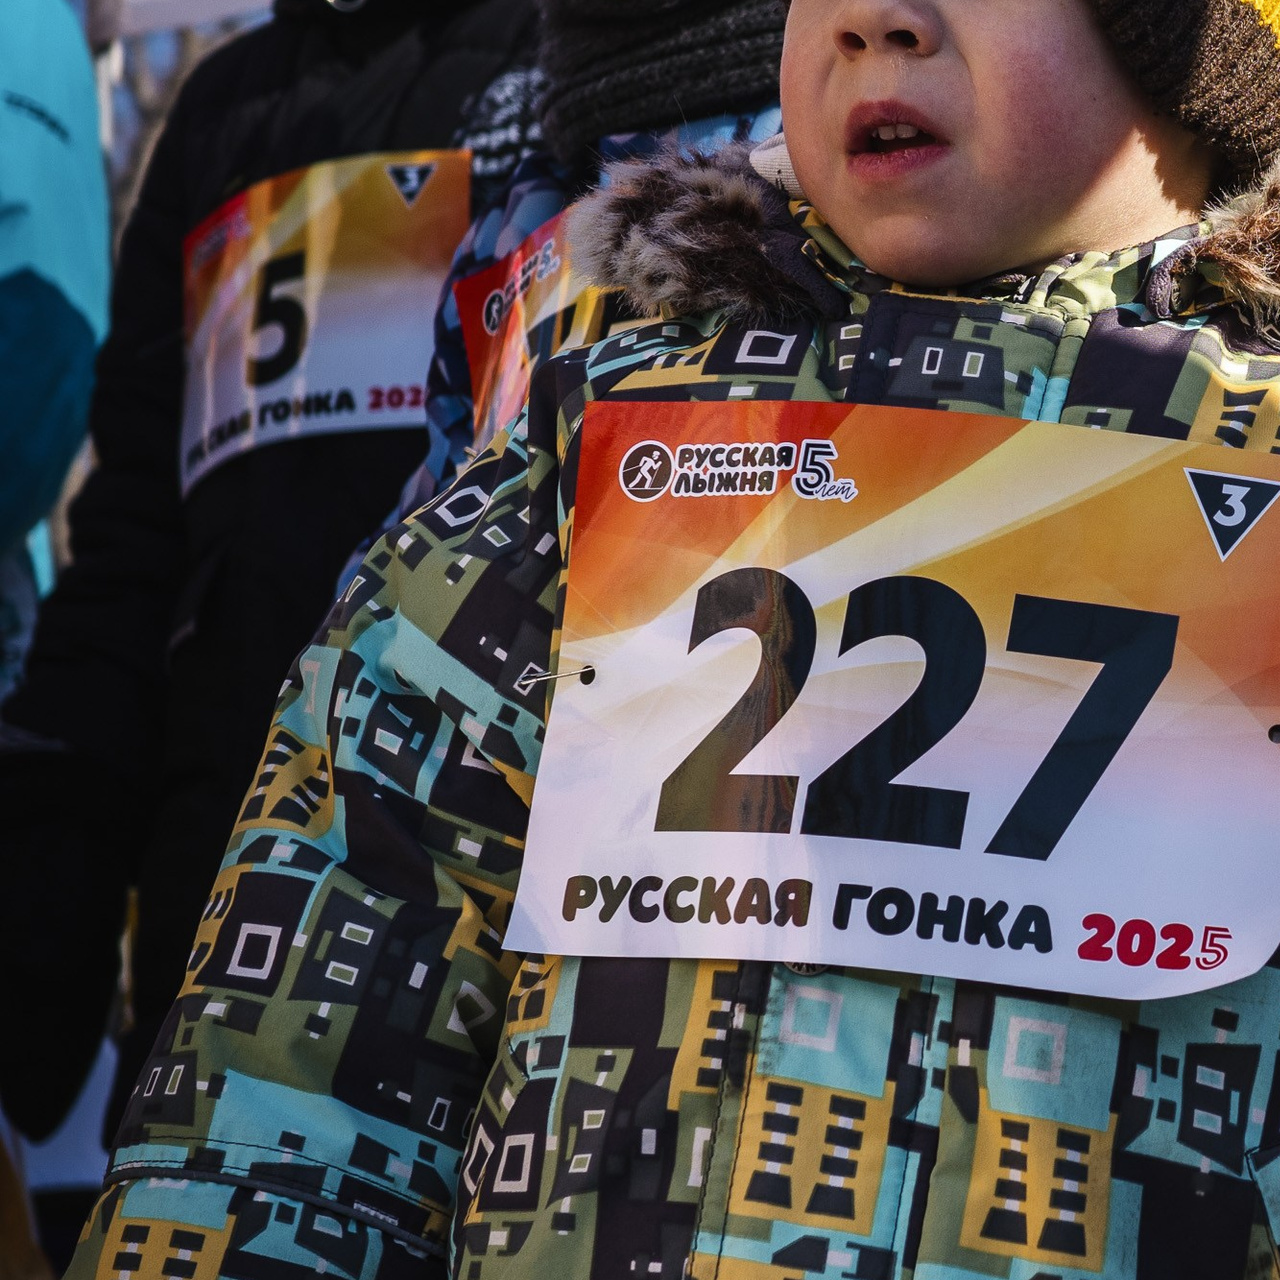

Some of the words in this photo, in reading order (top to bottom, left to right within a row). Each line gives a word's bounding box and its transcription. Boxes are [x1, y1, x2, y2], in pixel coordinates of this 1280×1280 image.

[402, 168, 421, 191] 3
[246, 247, 309, 389] 5
[257, 388, 357, 428] ГОНКА
[367, 385, 427, 411] 202
[678, 445, 794, 470] РУССКАЯ
[795, 442, 836, 496] 5
[674, 470, 775, 494] ЛЫЖНЯ
[814, 480, 856, 499] лет
[1212, 483, 1249, 527] 3
[653, 566, 1180, 862] 227
[561, 874, 814, 928] РУССКАЯ
[831, 882, 1054, 954] ГОНКА
[1077, 912, 1234, 971] 2025
